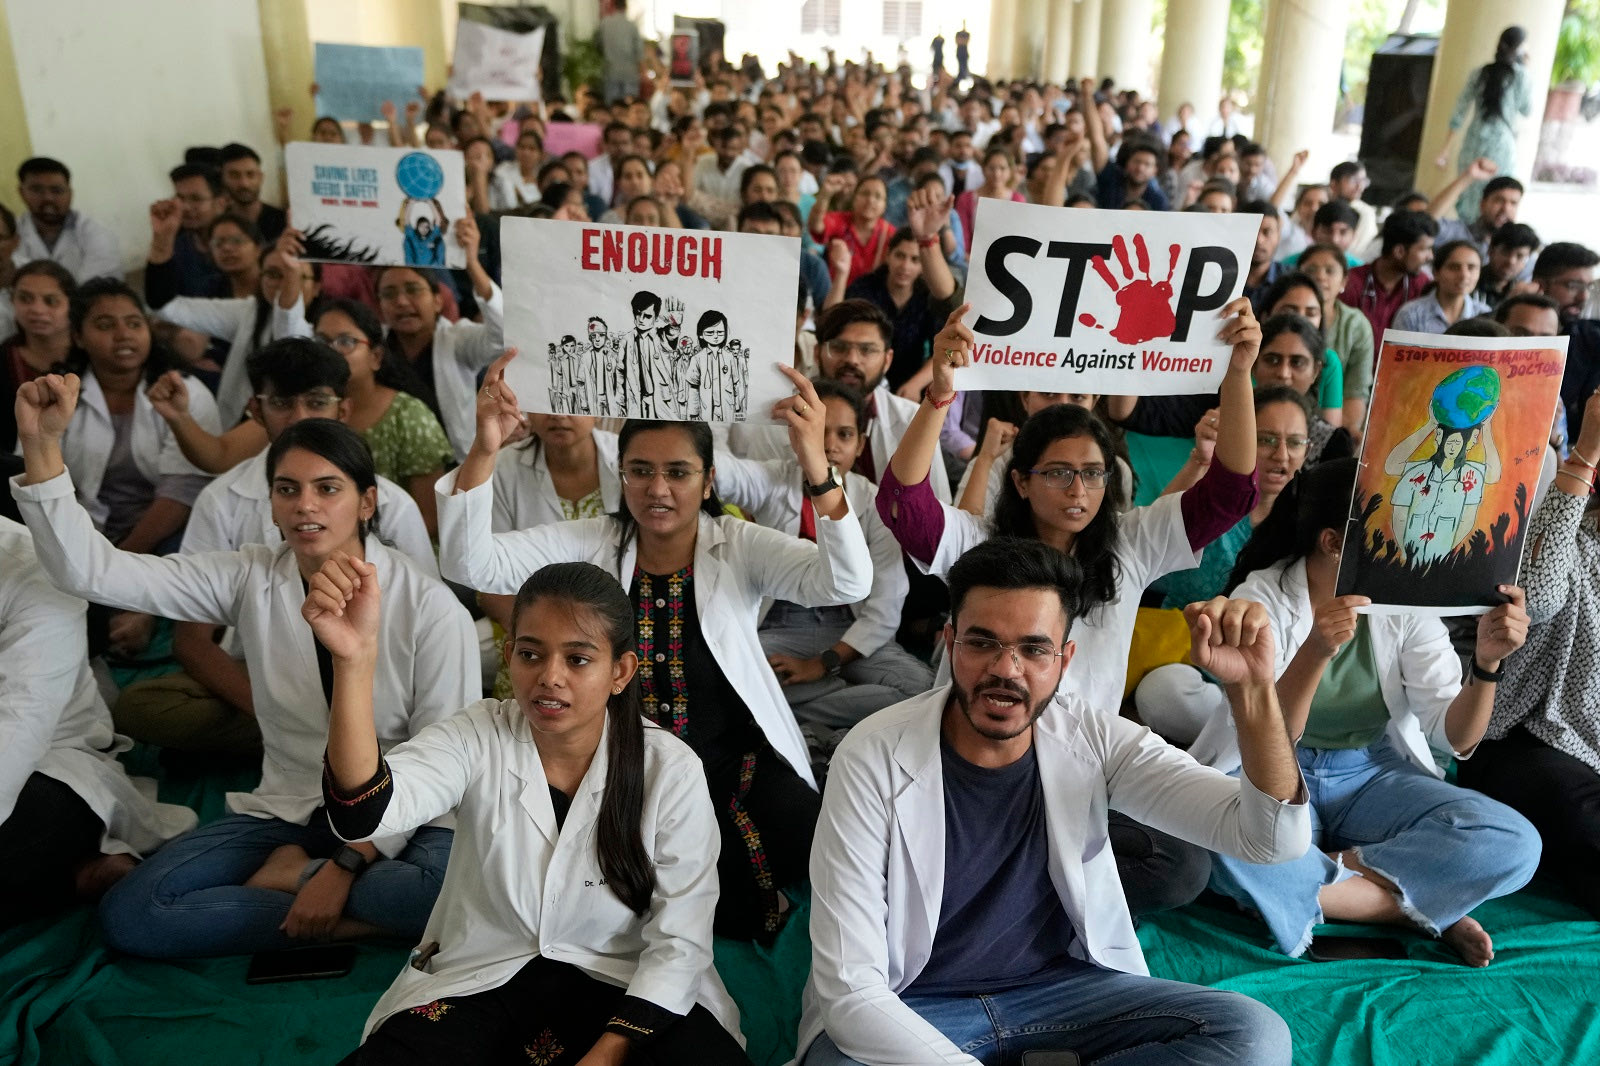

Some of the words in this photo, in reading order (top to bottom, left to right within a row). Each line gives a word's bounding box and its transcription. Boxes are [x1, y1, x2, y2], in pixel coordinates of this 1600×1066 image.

[314, 165, 348, 181] SAVING
[351, 168, 378, 183] LIVES
[311, 181, 340, 196] NEEDS
[344, 184, 378, 200] SAFETY
[581, 228, 723, 282] ENOUGH
[972, 343, 1057, 367] Violence
[1061, 348, 1136, 373] Against
[1142, 350, 1213, 373] Women
[1394, 349, 1428, 363] STOP
[1434, 350, 1496, 364] VIOLENCE
[1498, 351, 1542, 366] AGAINST
